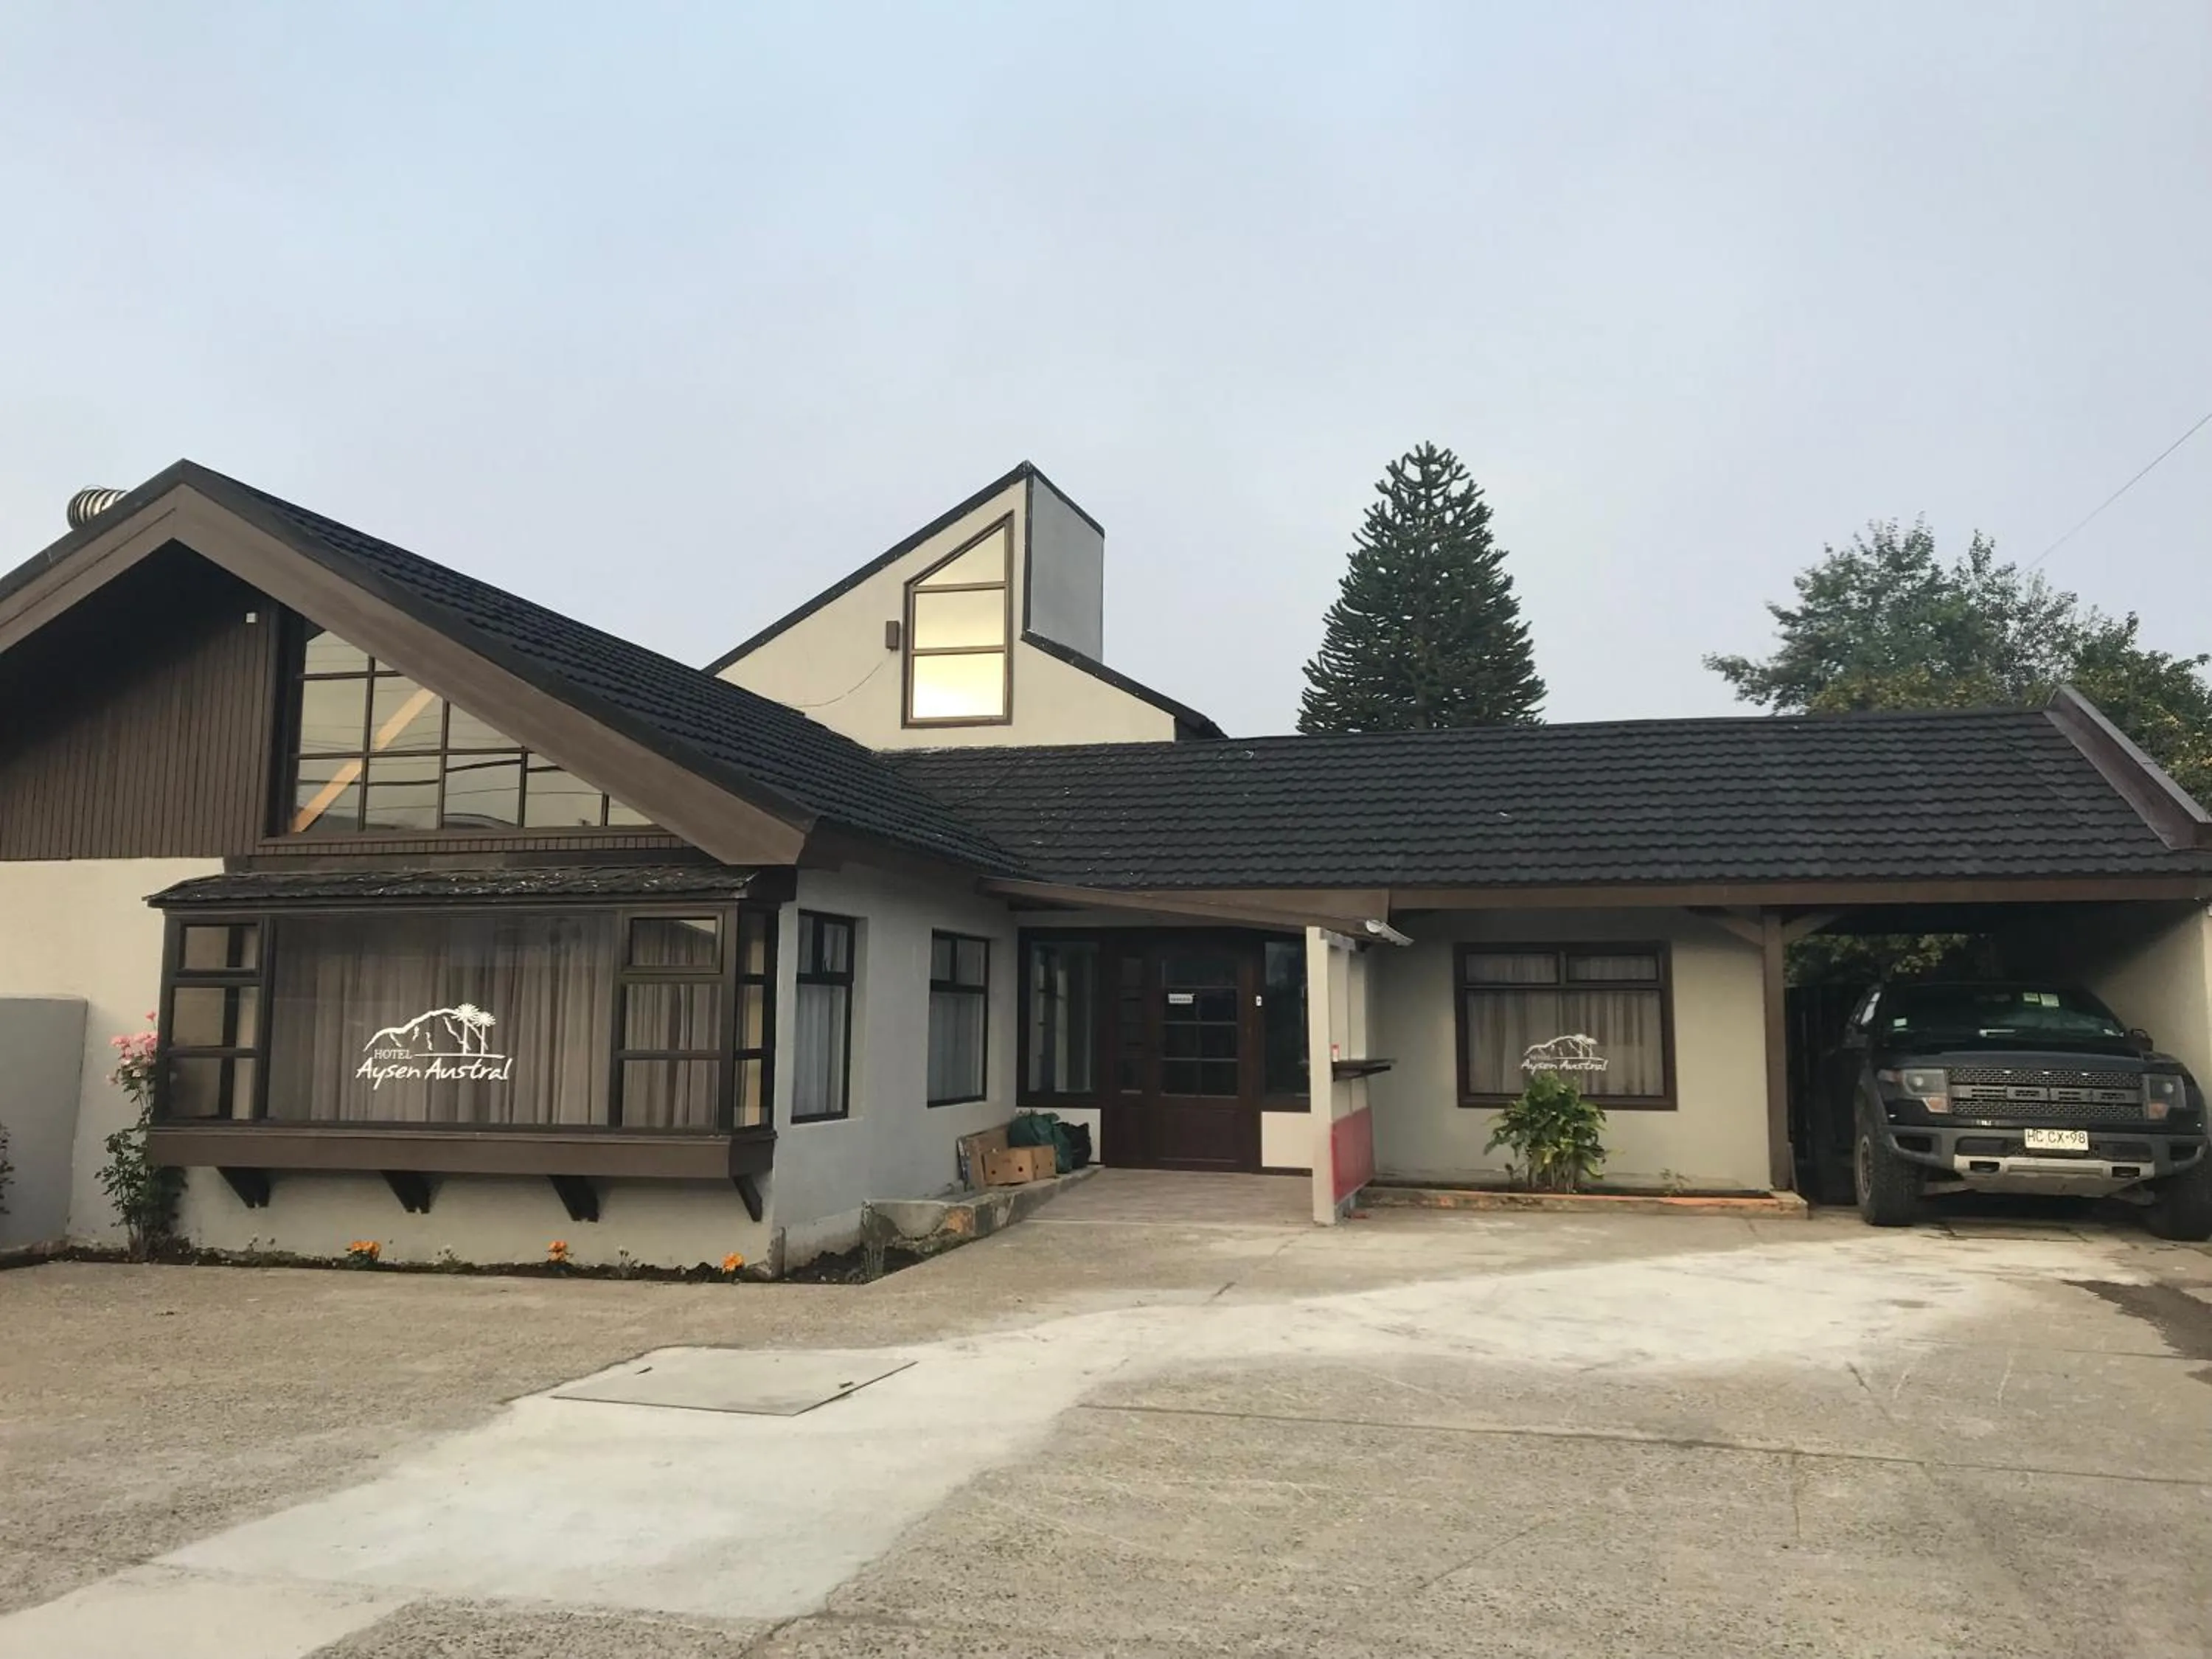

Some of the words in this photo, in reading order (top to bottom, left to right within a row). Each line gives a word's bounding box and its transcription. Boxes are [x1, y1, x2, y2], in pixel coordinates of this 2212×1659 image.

[373, 1049, 413, 1060] HOTEL
[355, 1057, 421, 1091] Aysen
[424, 1057, 513, 1080] Austral
